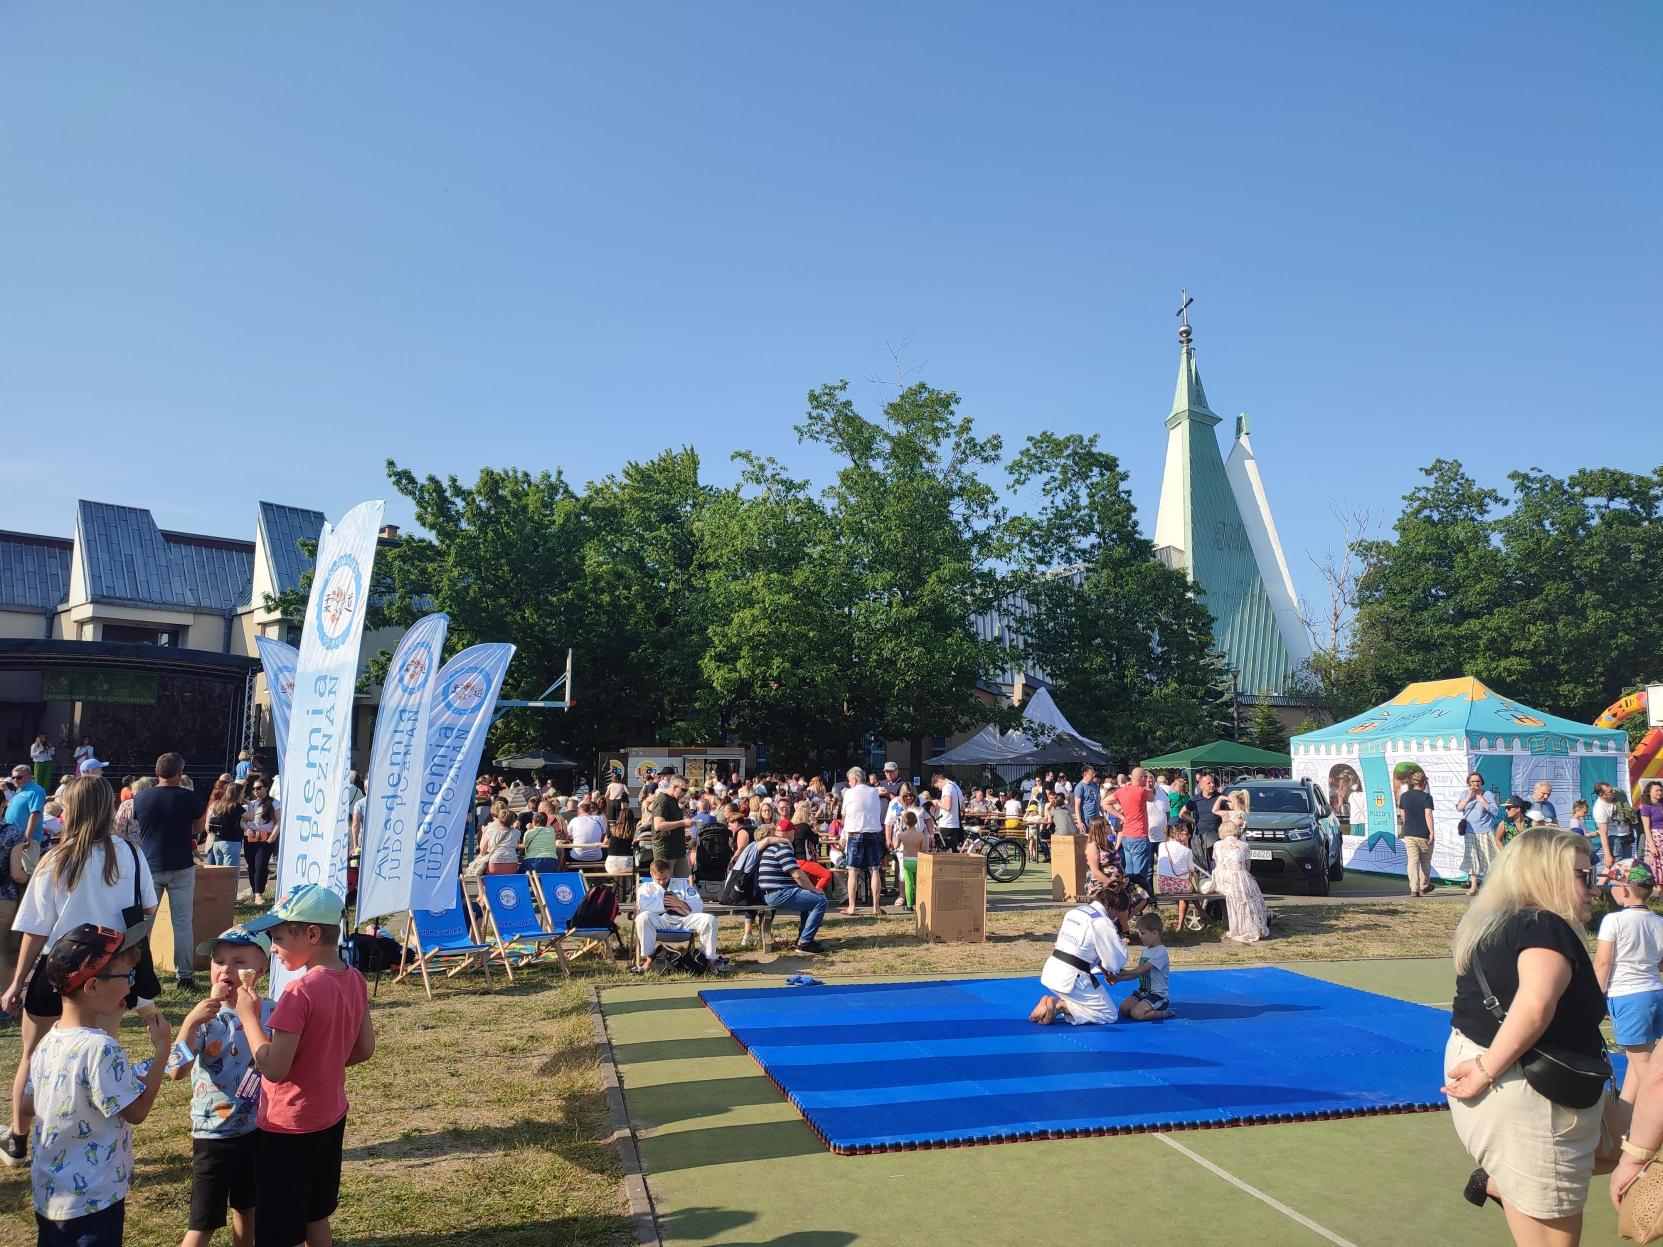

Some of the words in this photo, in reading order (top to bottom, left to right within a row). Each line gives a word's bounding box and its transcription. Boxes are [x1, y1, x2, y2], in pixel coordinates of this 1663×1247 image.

[295, 674, 328, 878] ademia
[374, 708, 408, 881] Akademia
[388, 819, 404, 881] JUDO
[413, 725, 455, 881] Akademia
[425, 825, 447, 880] JUDO
